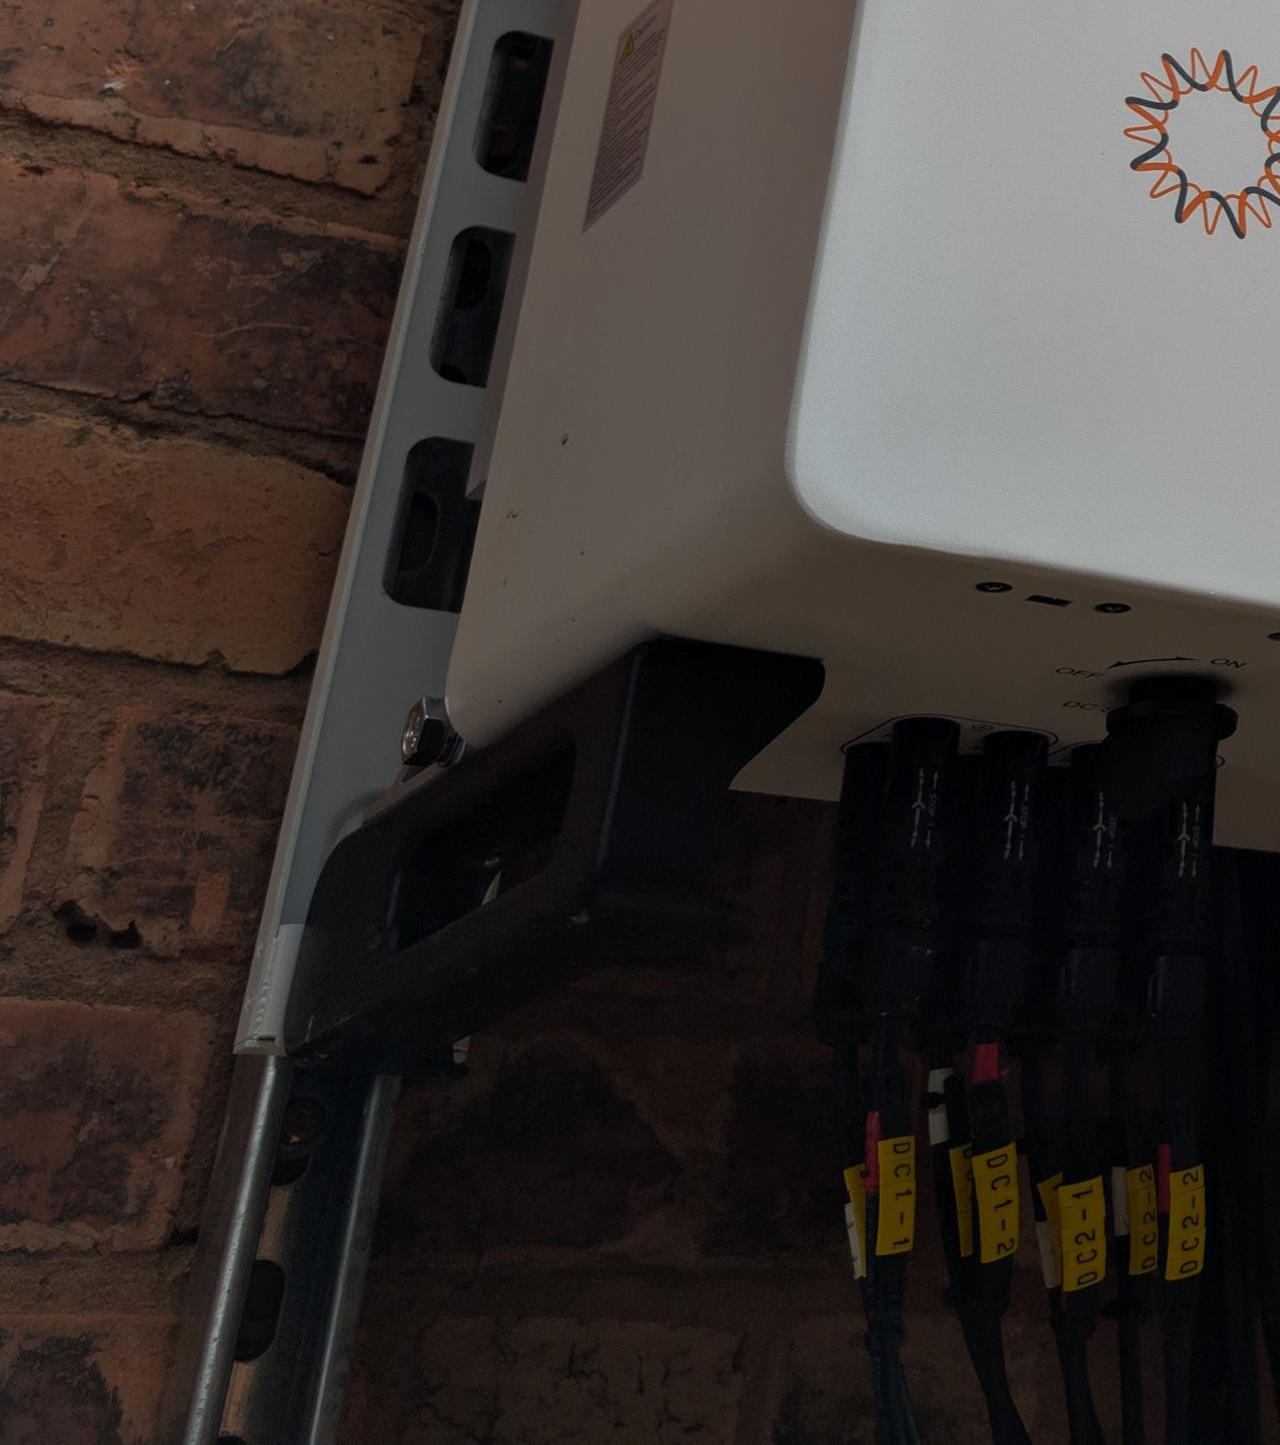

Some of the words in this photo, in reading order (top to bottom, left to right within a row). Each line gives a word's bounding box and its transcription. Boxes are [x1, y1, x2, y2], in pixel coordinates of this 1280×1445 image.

[1056, 666, 1105, 679] OFF
[1209, 657, 1248, 669] ON
[927, 792, 938, 817] STOP
[893, 1141, 912, 1248] DC1-1
[987, 1153, 1015, 1254] DC1-2
[1072, 1185, 1099, 1286] DC2-1
[1139, 1169, 1157, 1270] DC2-2
[1180, 1168, 1201, 1274] DC2-2
